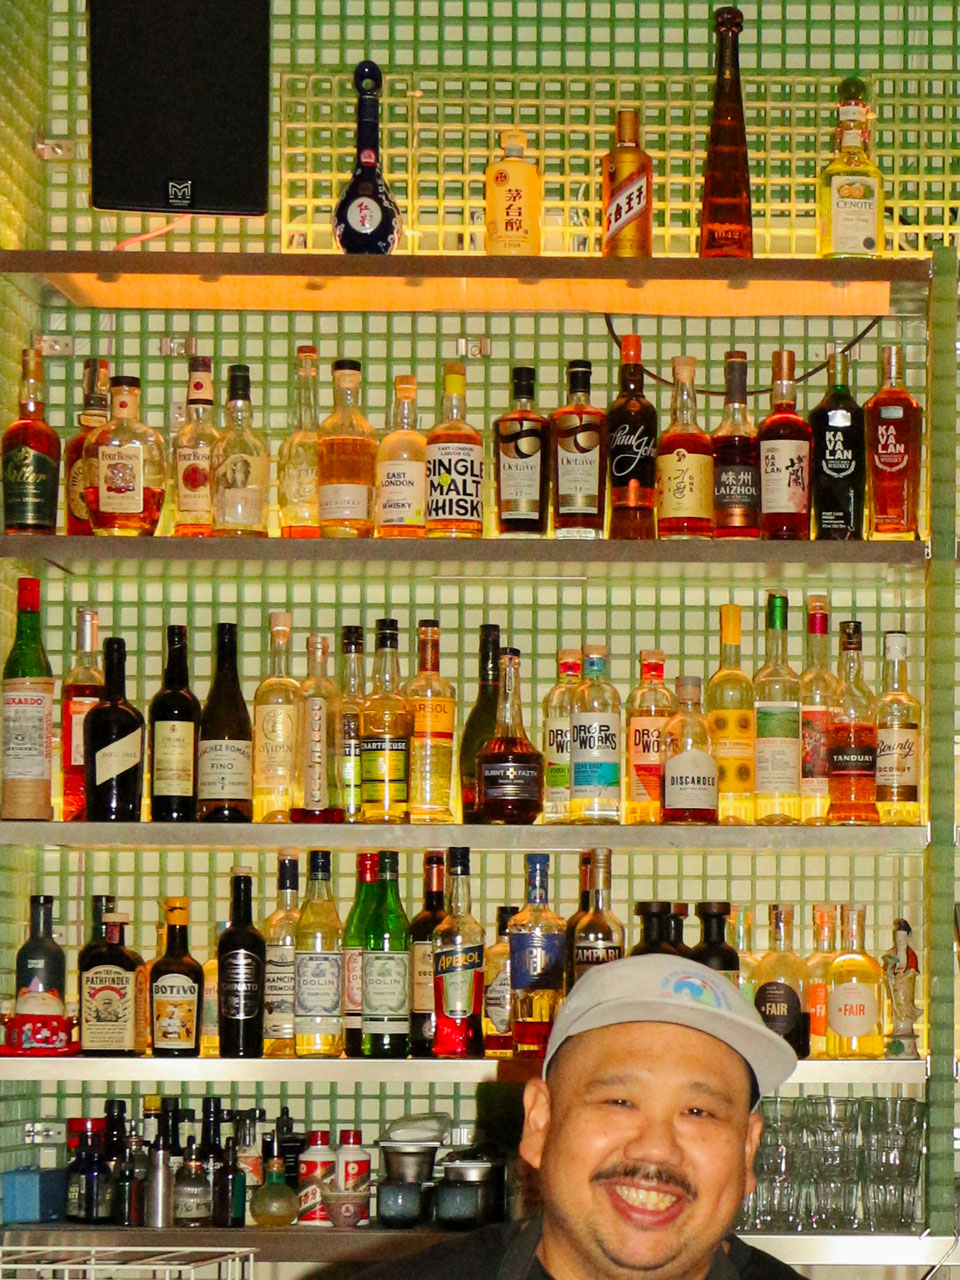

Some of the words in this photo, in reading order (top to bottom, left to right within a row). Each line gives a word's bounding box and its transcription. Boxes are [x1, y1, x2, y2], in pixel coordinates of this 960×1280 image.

[836, 199, 875, 210] CENOTE
[611, 424, 645, 448] Paul
[877, 425, 896, 436] KA
[825, 431, 844, 442] KA
[878, 435, 896, 444] VA
[825, 441, 845, 451] VA
[877, 443, 905, 454] LAN
[101, 450, 118, 462] Four
[177, 450, 193, 462] Four
[825, 450, 852, 460] LAN
[561, 456, 595, 467] Octave
[503, 462, 537, 473] Octave
[386, 472, 406, 480] EAST
[381, 480, 414, 489] LONDON
[429, 479, 482, 498] MALT
[409, 703, 449, 714] ARSOL
[572, 724, 611, 744] DROP
[361, 742, 406, 750] CHARTREUSE
[578, 732, 617, 751] WORKS
[876, 738, 915, 759] Bounty
[211, 762, 234, 770] FINO
[670, 776, 716, 787] DISCARDED
[438, 951, 481, 972] APEROL
[103, 969, 113, 977] THE
[85, 976, 130, 985] PATHFINDER
[302, 977, 335, 986] DOLIN
[368, 977, 401, 985] DOLIN
[765, 1002, 788, 1016] FAIR
[843, 1003, 866, 1016] FAIR
